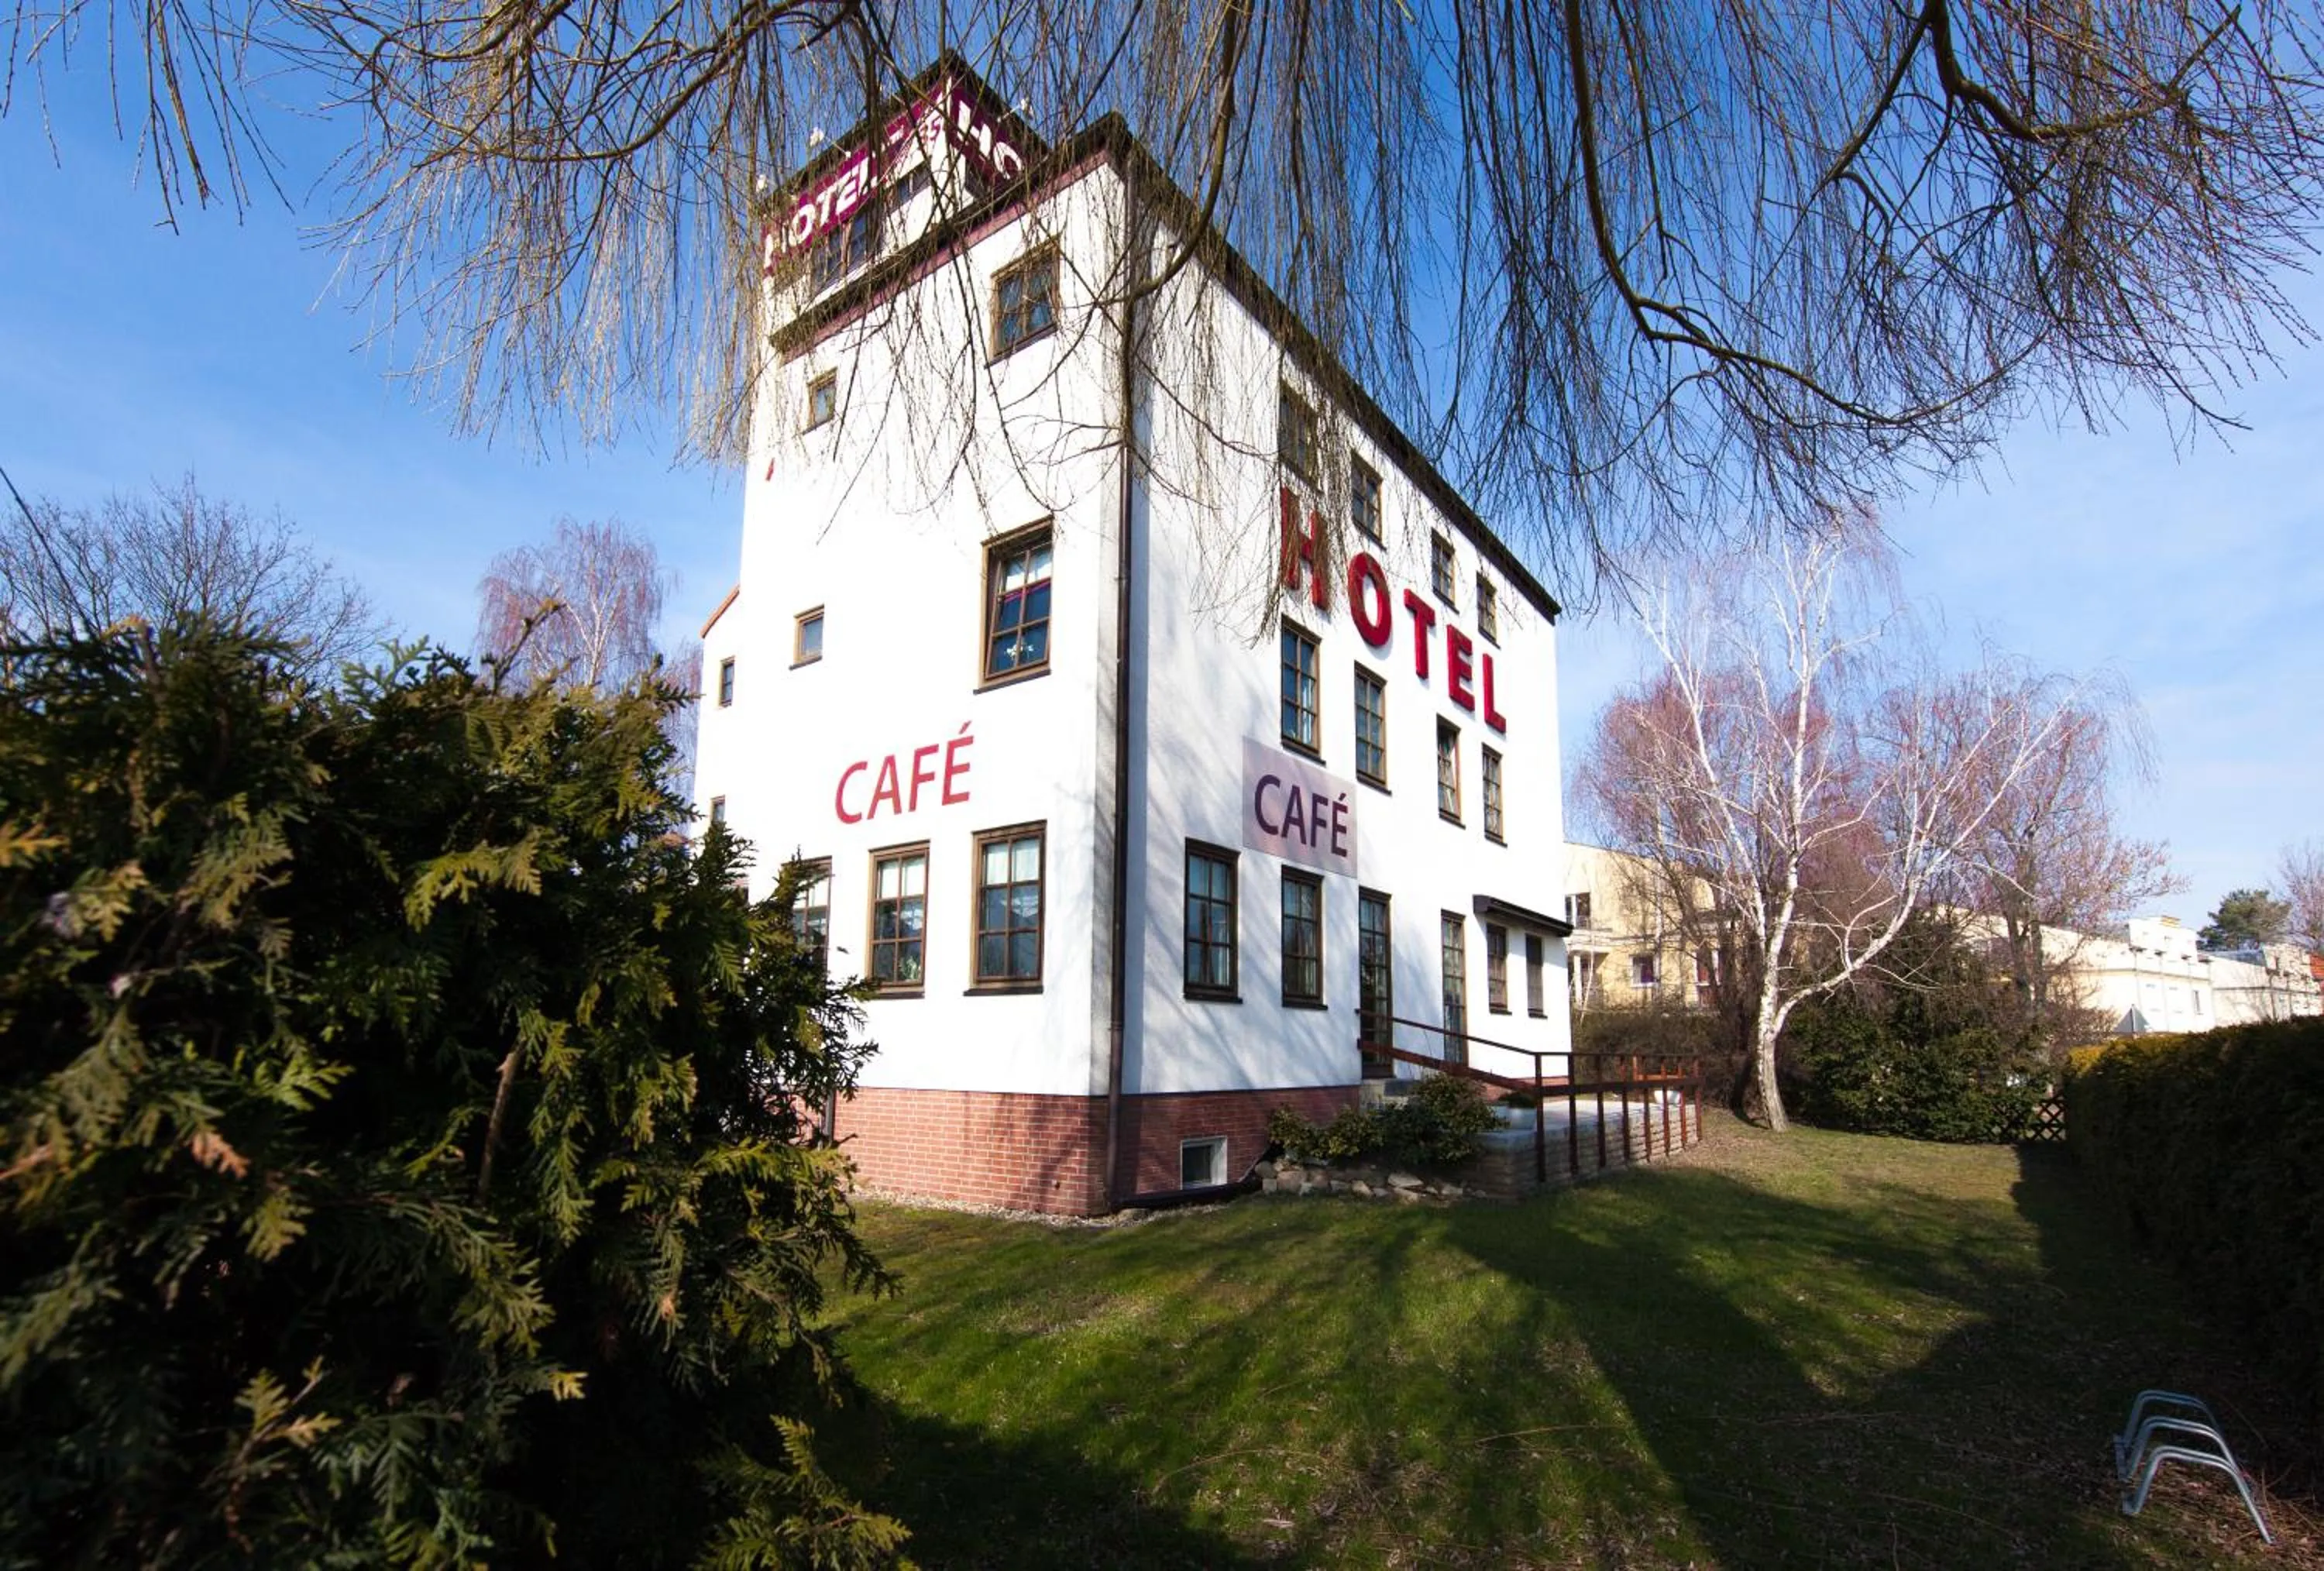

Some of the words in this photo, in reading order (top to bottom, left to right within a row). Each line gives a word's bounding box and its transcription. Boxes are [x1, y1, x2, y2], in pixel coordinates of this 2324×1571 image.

[1281, 485, 1506, 734] HOTEL
[835, 721, 975, 824] CAFÉ
[1254, 774, 1348, 858] CAFÉ
